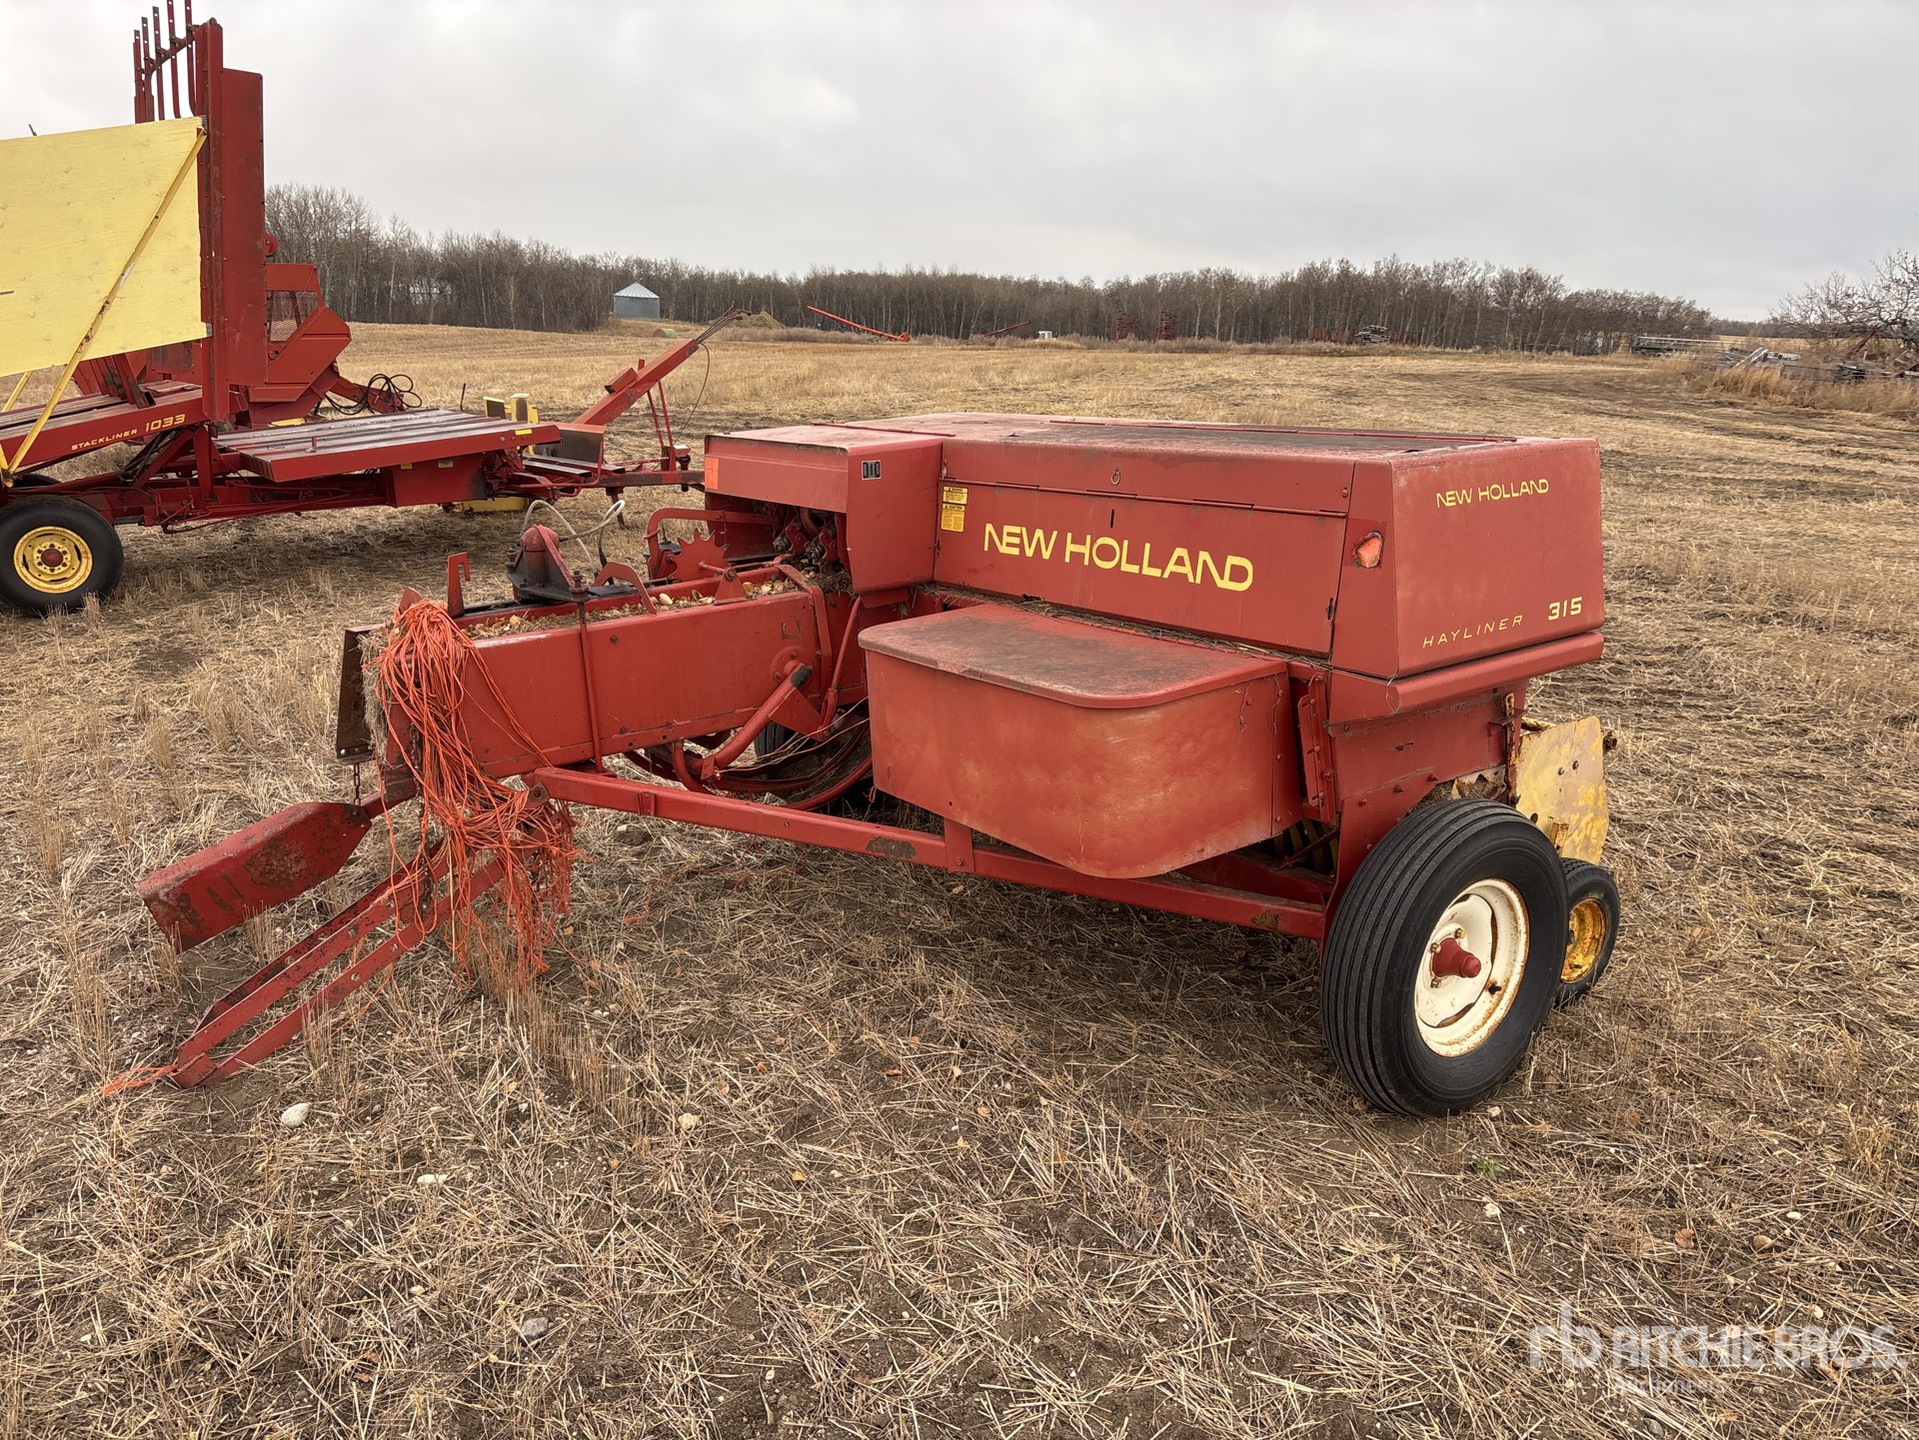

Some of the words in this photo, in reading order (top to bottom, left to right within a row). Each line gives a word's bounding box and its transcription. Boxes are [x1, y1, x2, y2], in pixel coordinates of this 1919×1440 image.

[71, 429, 138, 450] STACKLINER
[145, 413, 186, 432] 1033
[1436, 488, 1473, 508] NEW
[1478, 479, 1549, 502] HOLLAND
[984, 523, 1058, 560] NEW
[1064, 532, 1254, 592] HOLLAND
[1422, 614, 1523, 648] HAYLINER
[1547, 596, 1583, 621] 315
